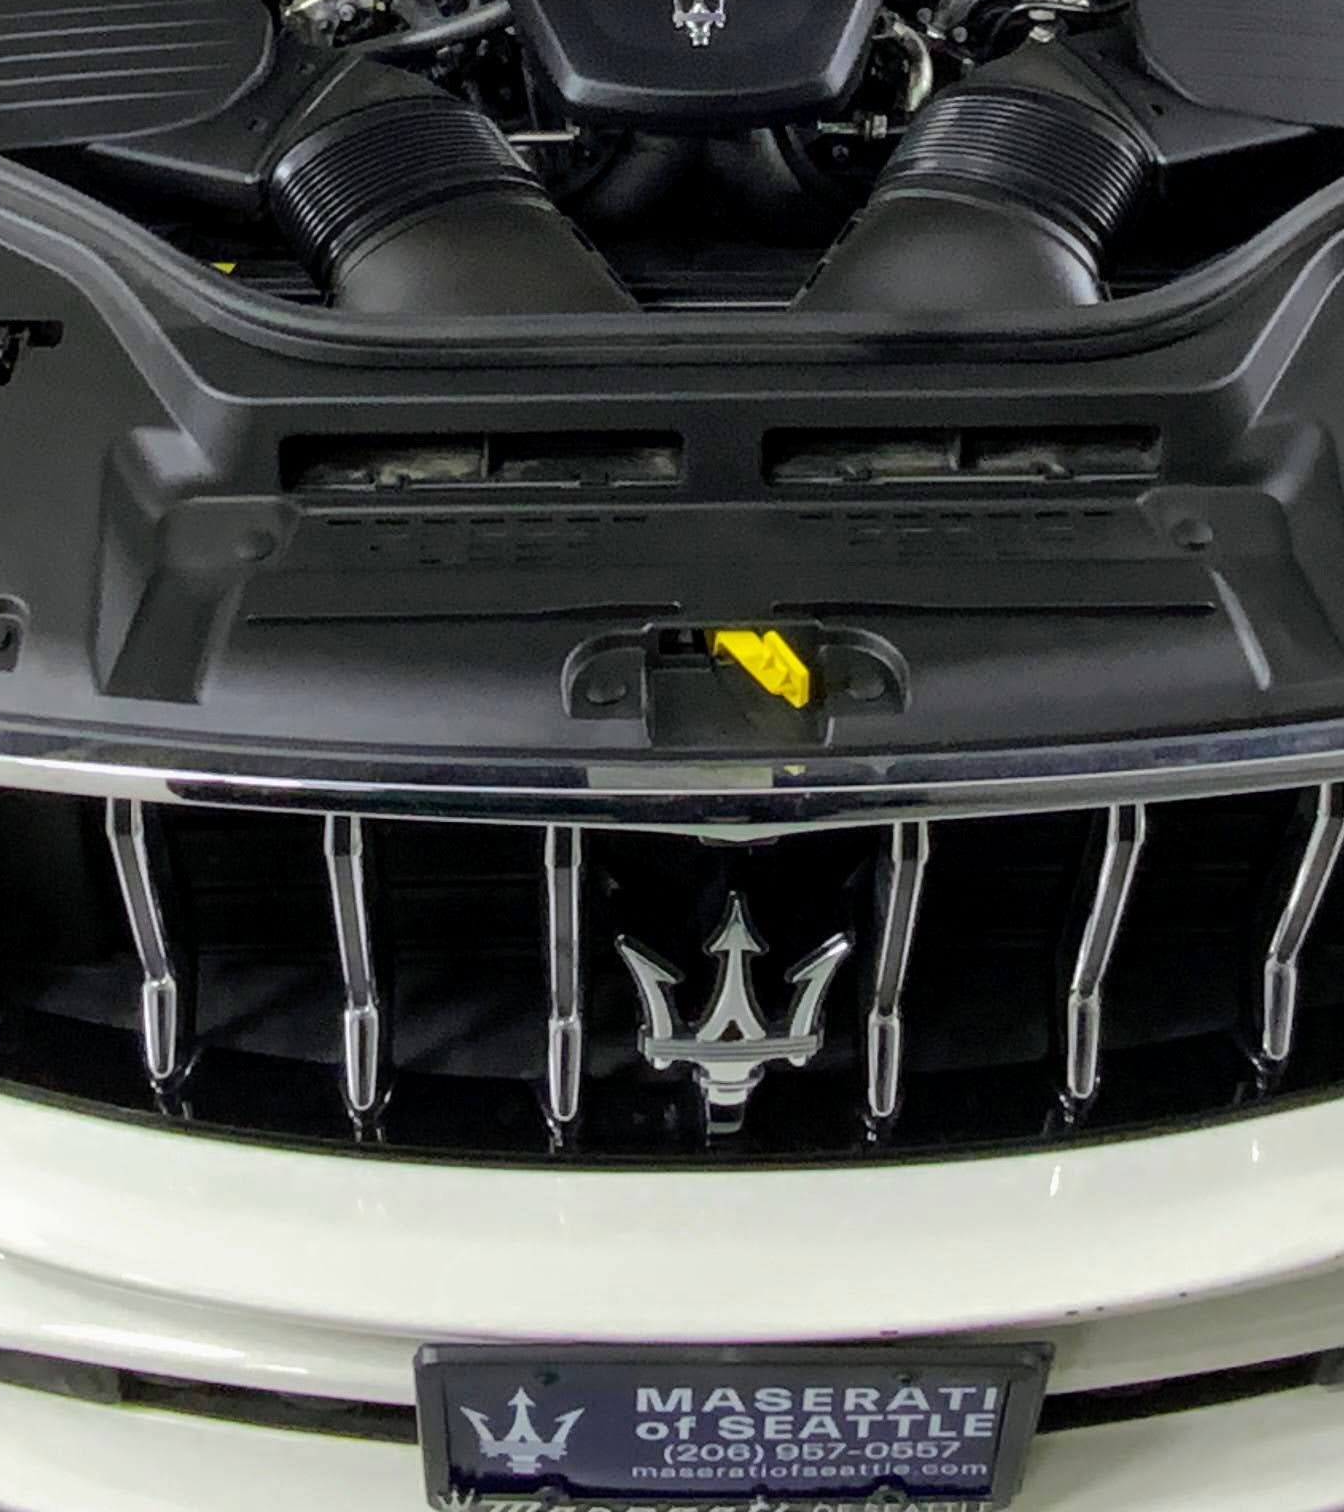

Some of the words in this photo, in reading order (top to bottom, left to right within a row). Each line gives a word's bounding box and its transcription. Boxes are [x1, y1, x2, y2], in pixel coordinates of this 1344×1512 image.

[636, 1387, 998, 1412] MASERATI
[635, 1416, 697, 1440] of
[718, 1413, 995, 1440] SEATTLE
[663, 1443, 764, 1464] (206)
[775, 1441, 961, 1462] 957-0557
[631, 1462, 988, 1479] maseratiofseattle.com
